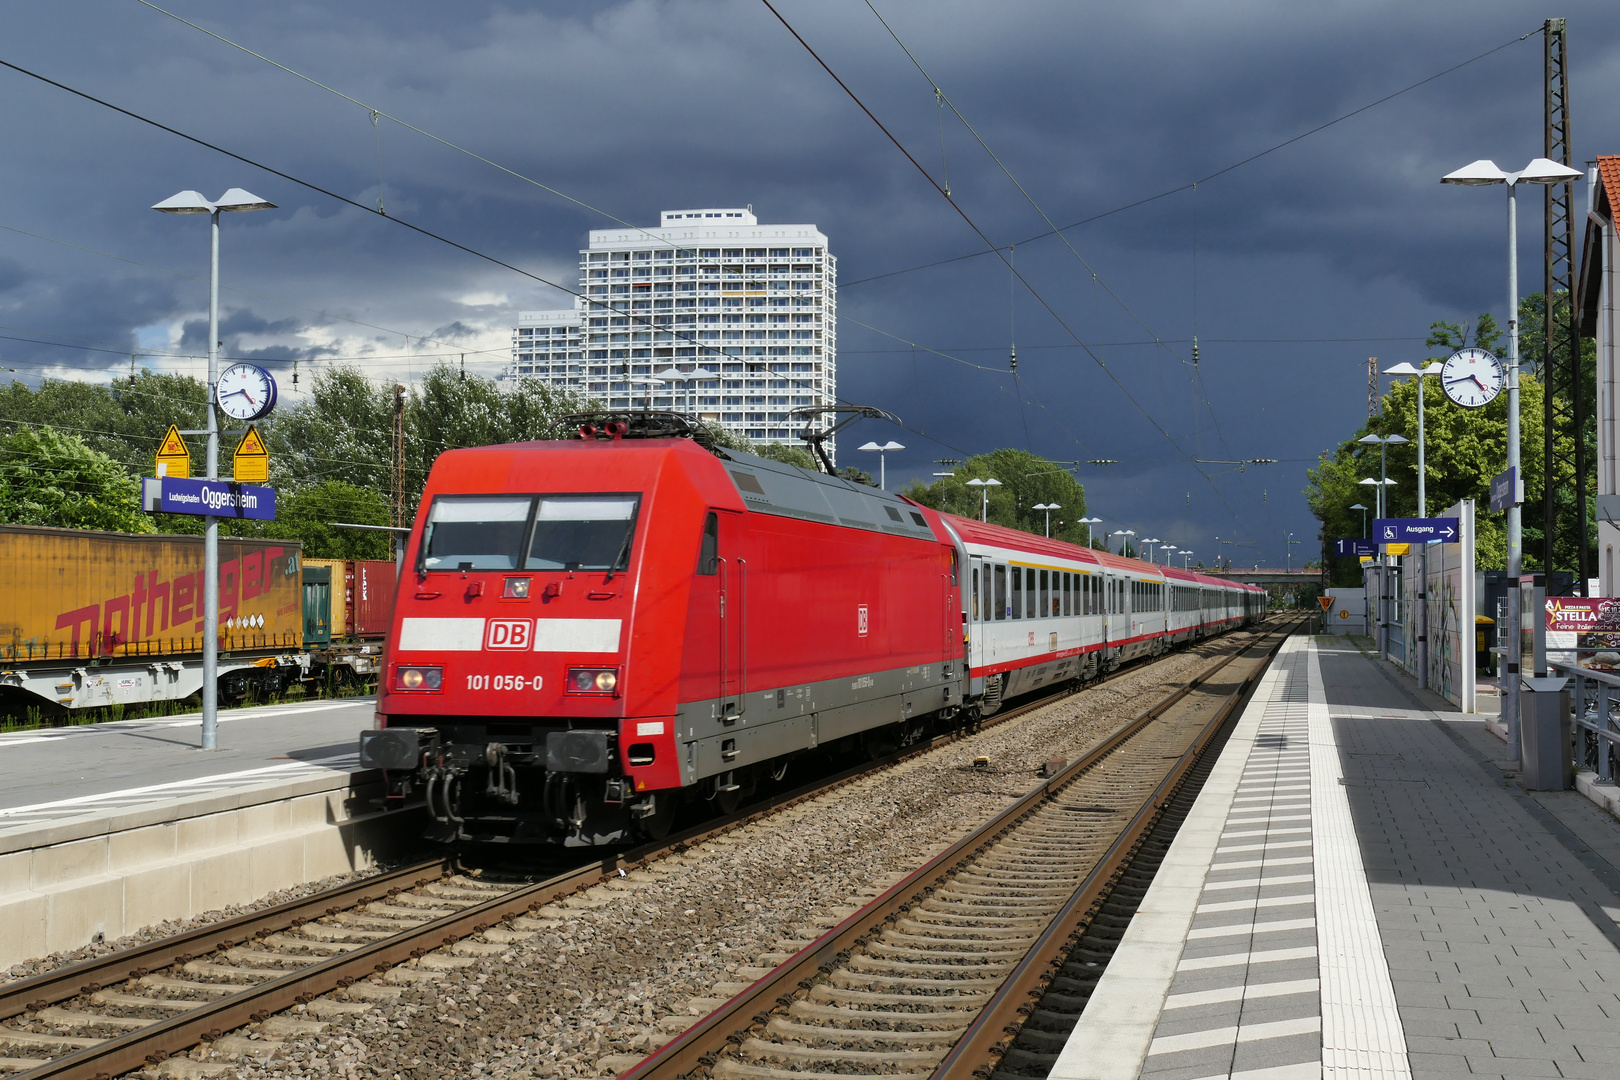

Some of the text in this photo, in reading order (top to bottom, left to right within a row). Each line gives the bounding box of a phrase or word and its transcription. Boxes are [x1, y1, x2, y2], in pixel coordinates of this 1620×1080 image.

[169, 486, 257, 509] Ludwigshafen Oggersheim
[1406, 526, 1434, 534] Ausgang
[1337, 540, 1344, 553] 1
[1322, 598, 1330, 606] 13
[1556, 612, 1598, 622] STELLA
[492, 624, 526, 644] DB
[466, 675, 543, 690] 101 056-0
